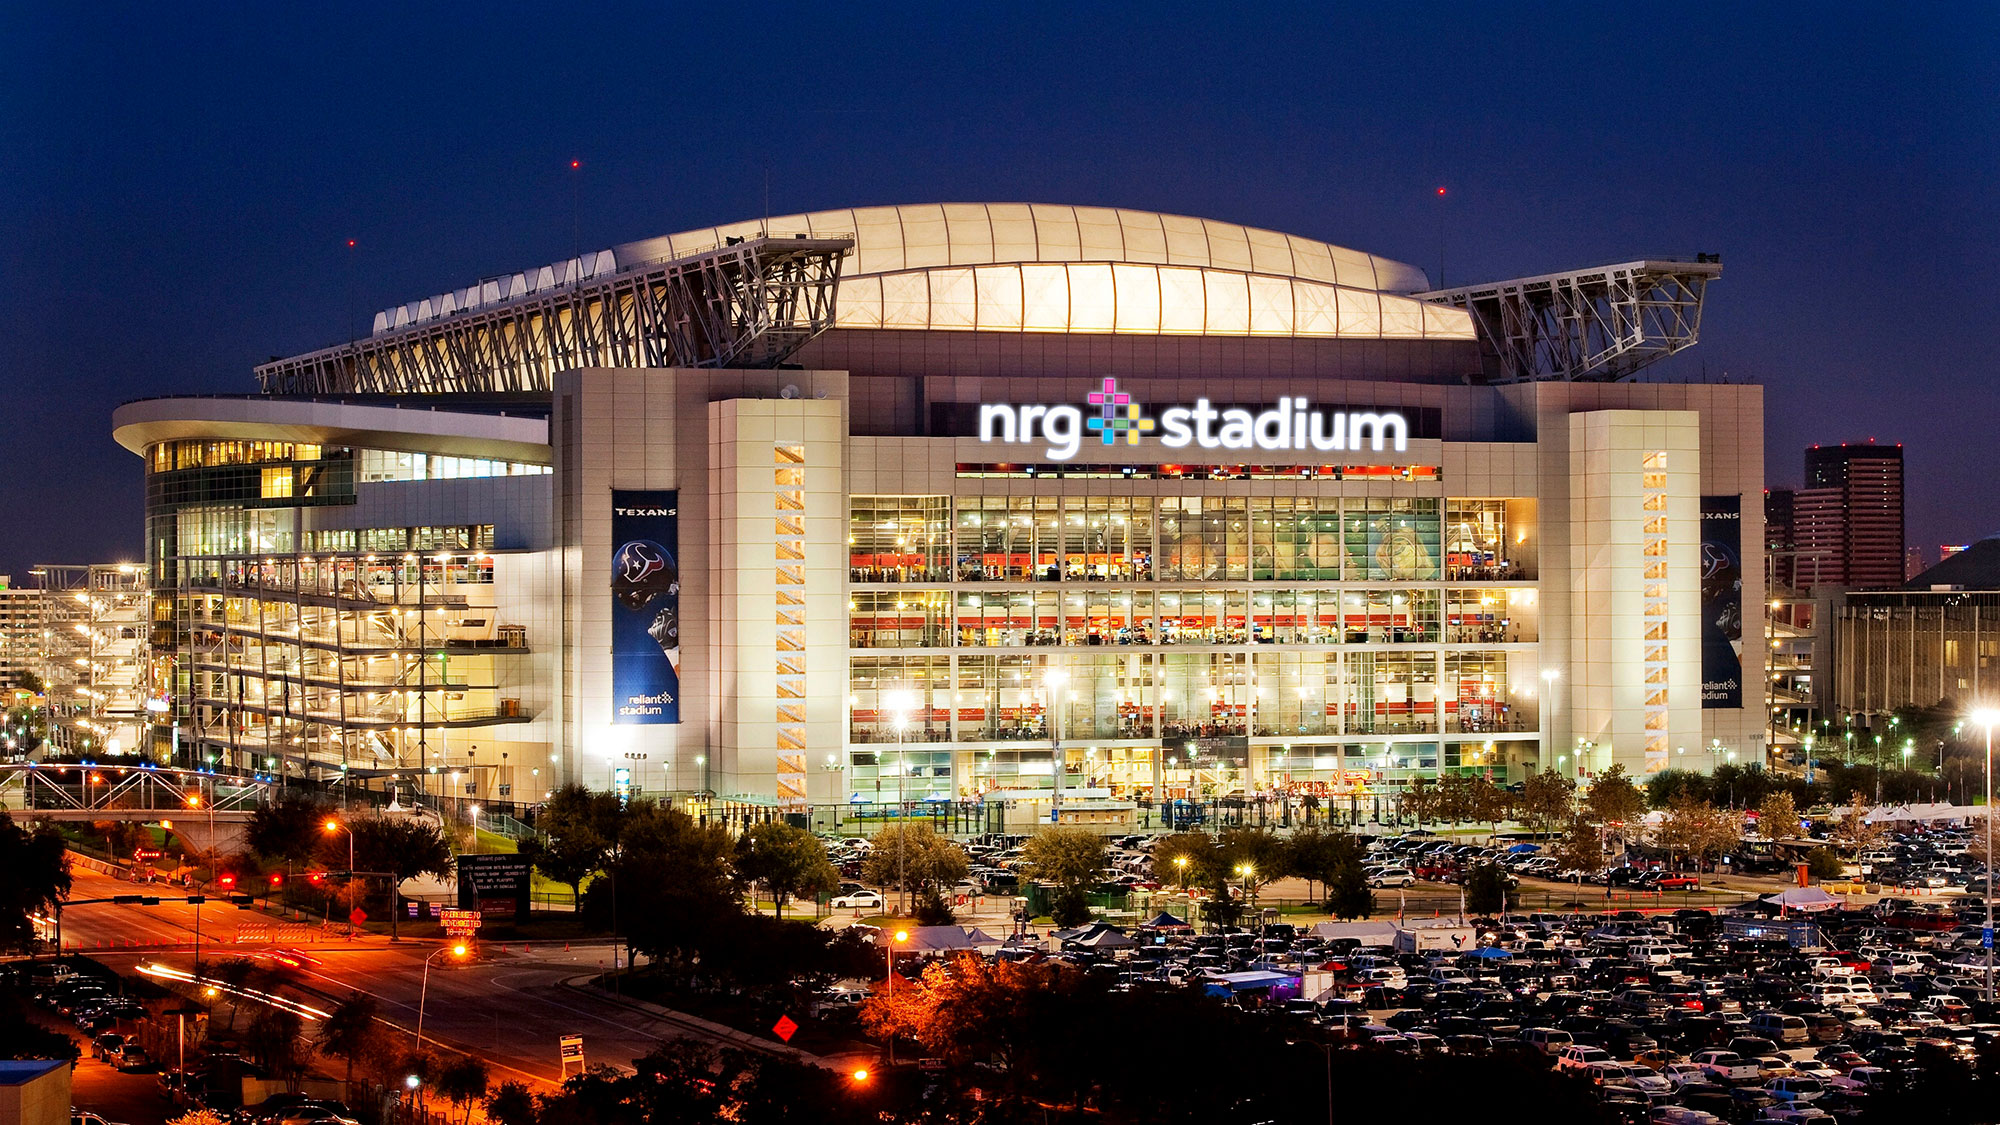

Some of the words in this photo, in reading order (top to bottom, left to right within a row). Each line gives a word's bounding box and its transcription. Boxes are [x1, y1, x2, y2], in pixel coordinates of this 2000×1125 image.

[980, 403, 1081, 460] nrg
[1160, 397, 1407, 452] stadium
[615, 508, 676, 516] TEXANS
[629, 694, 662, 705] reliant
[619, 705, 662, 716] stadium
[1984, 936, 1993, 944] 23
